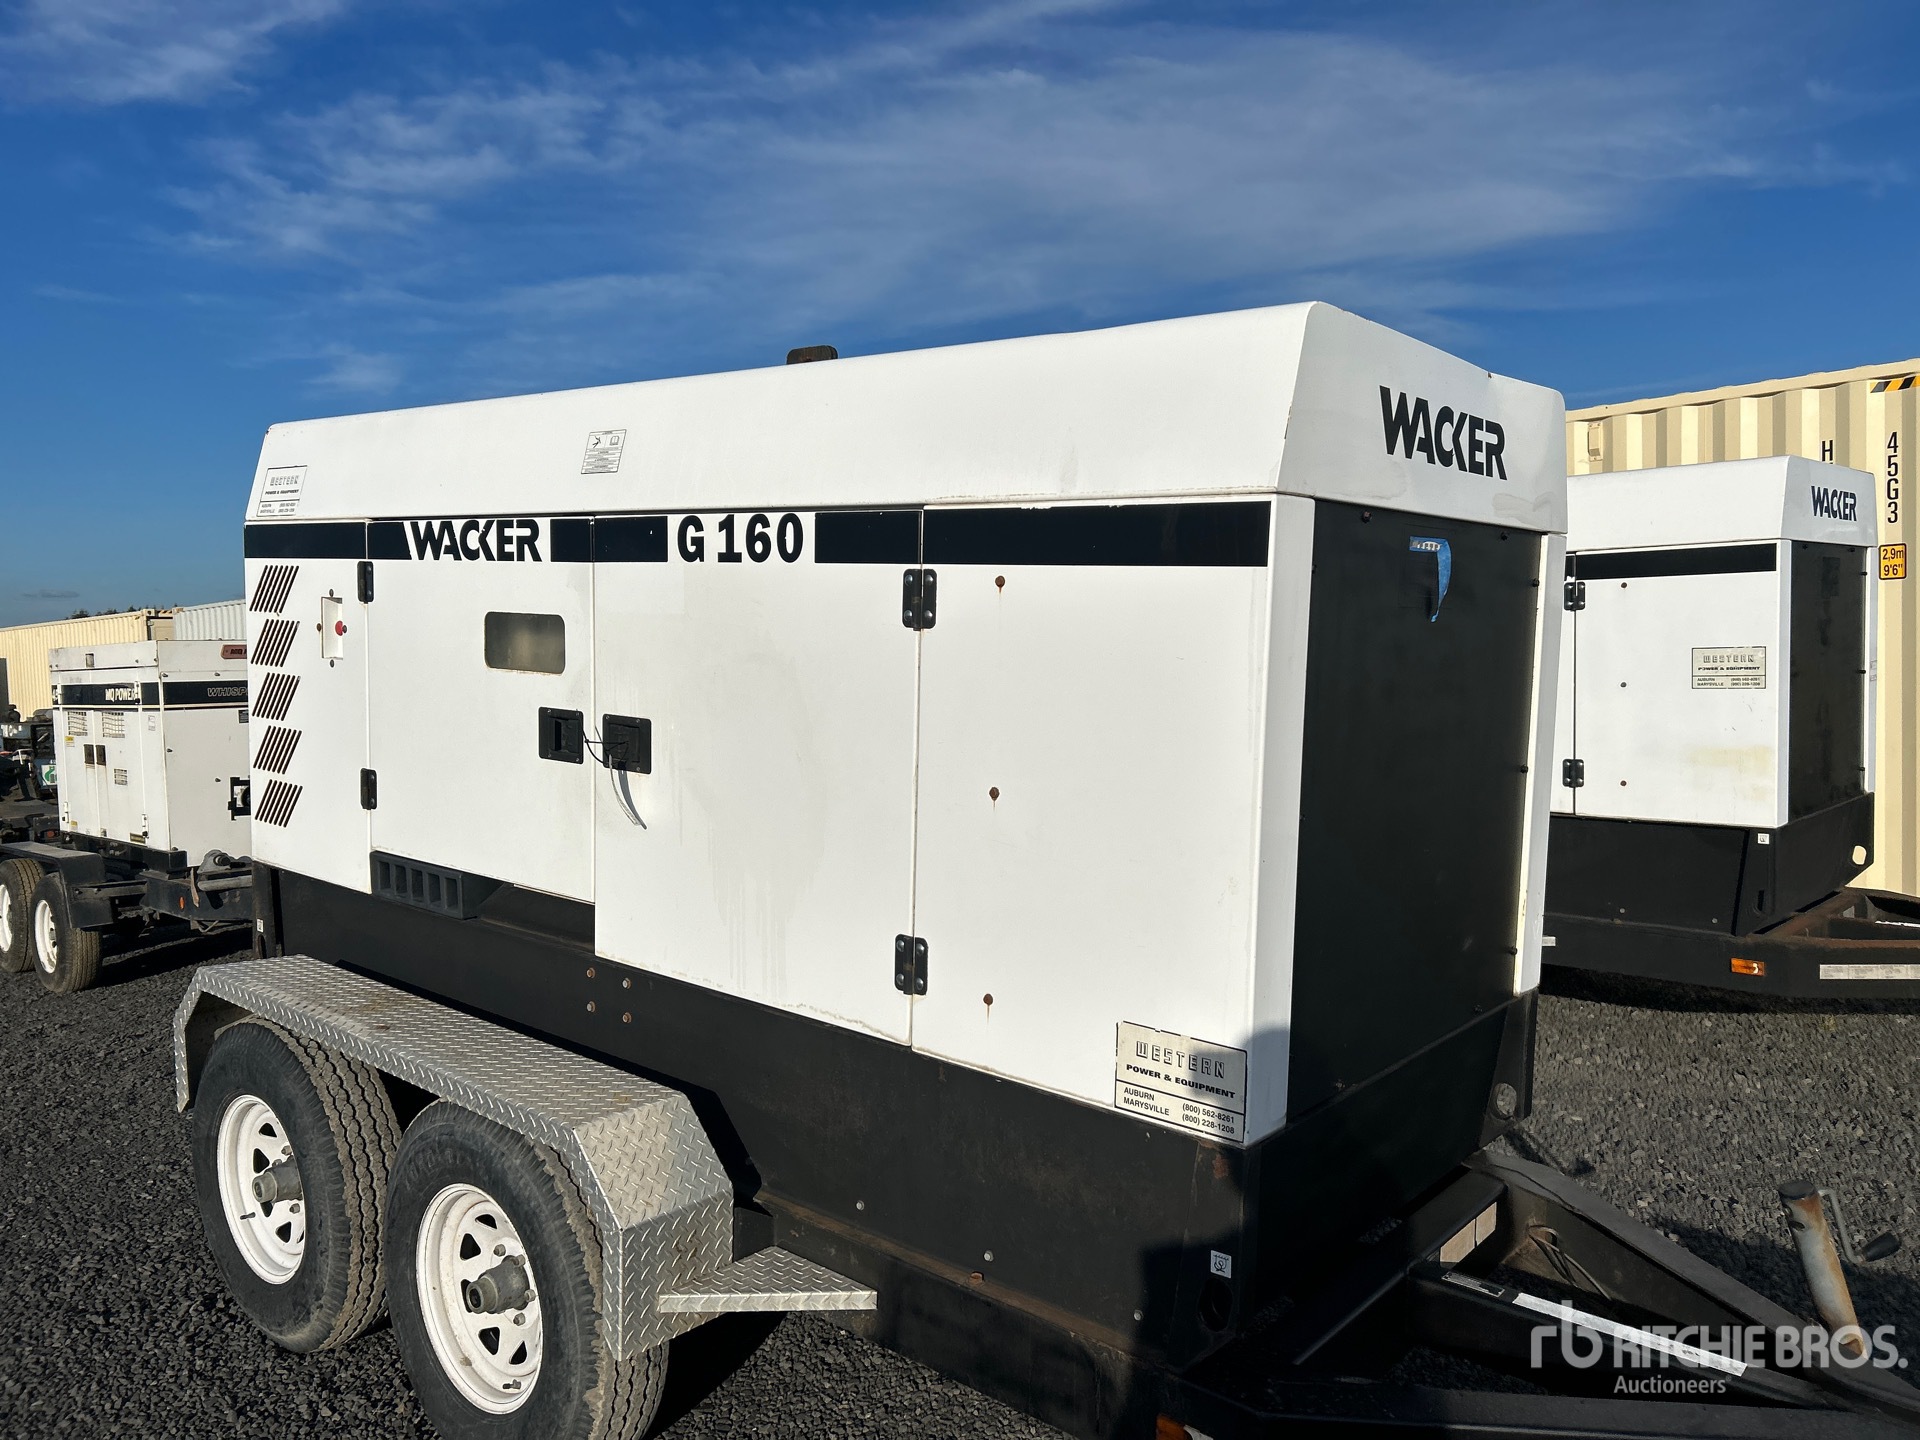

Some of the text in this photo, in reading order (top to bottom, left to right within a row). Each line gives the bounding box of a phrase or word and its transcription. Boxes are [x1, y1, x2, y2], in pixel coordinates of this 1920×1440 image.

[1379, 385, 1507, 481] WACKER
[1811, 485, 1857, 522] WACKER
[410, 518, 542, 562] WACKER
[1882, 547, 1904, 561] 2,9m
[1703, 654, 1754, 664] WESTERN
[207, 686, 248, 697] WHISP
[1136, 1041, 1225, 1079] WESTERN
[1126, 1064, 1236, 1099] POWER & EQUIPMENT
[1123, 1097, 1235, 1135] MARYSVILLE (800) 228-1208
[1124, 1087, 1155, 1101] AUBURN
[1182, 1103, 1201, 1115] (800)
